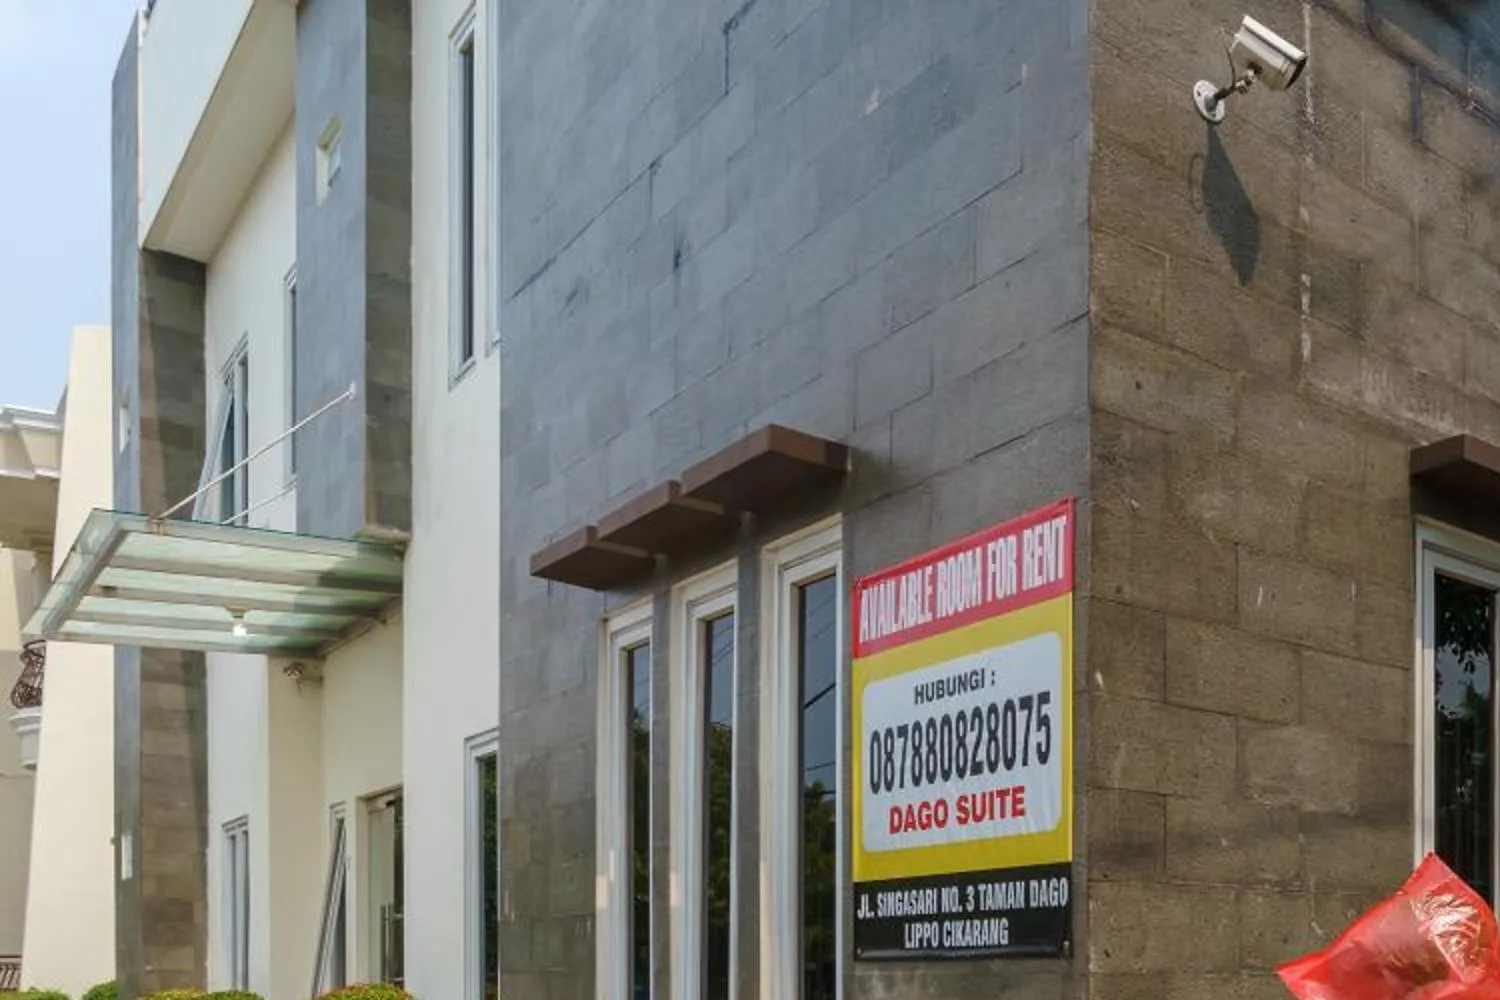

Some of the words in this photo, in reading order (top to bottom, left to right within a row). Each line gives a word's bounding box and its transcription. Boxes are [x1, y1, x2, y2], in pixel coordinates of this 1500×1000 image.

[859, 565, 933, 645] AVAILABLE
[936, 547, 983, 619] ROOM
[986, 534, 1018, 603] FOR
[1022, 514, 1067, 591] RENT
[914, 668, 986, 704] HUBUNGI
[869, 690, 1052, 796] 087880828075
[889, 797, 950, 835] DAGO
[955, 785, 1027, 826] SUITE
[857, 893, 875, 919] JL.
[877, 888, 938, 917] SINGASARI
[941, 885, 963, 913] NO.
[965, 885, 975, 912] 3
[977, 879, 1026, 911] TAMAN
[1029, 877, 1070, 908] DAGO
[904, 920, 940, 949] LIPPO
[942, 917, 1010, 948] CIKARANG
